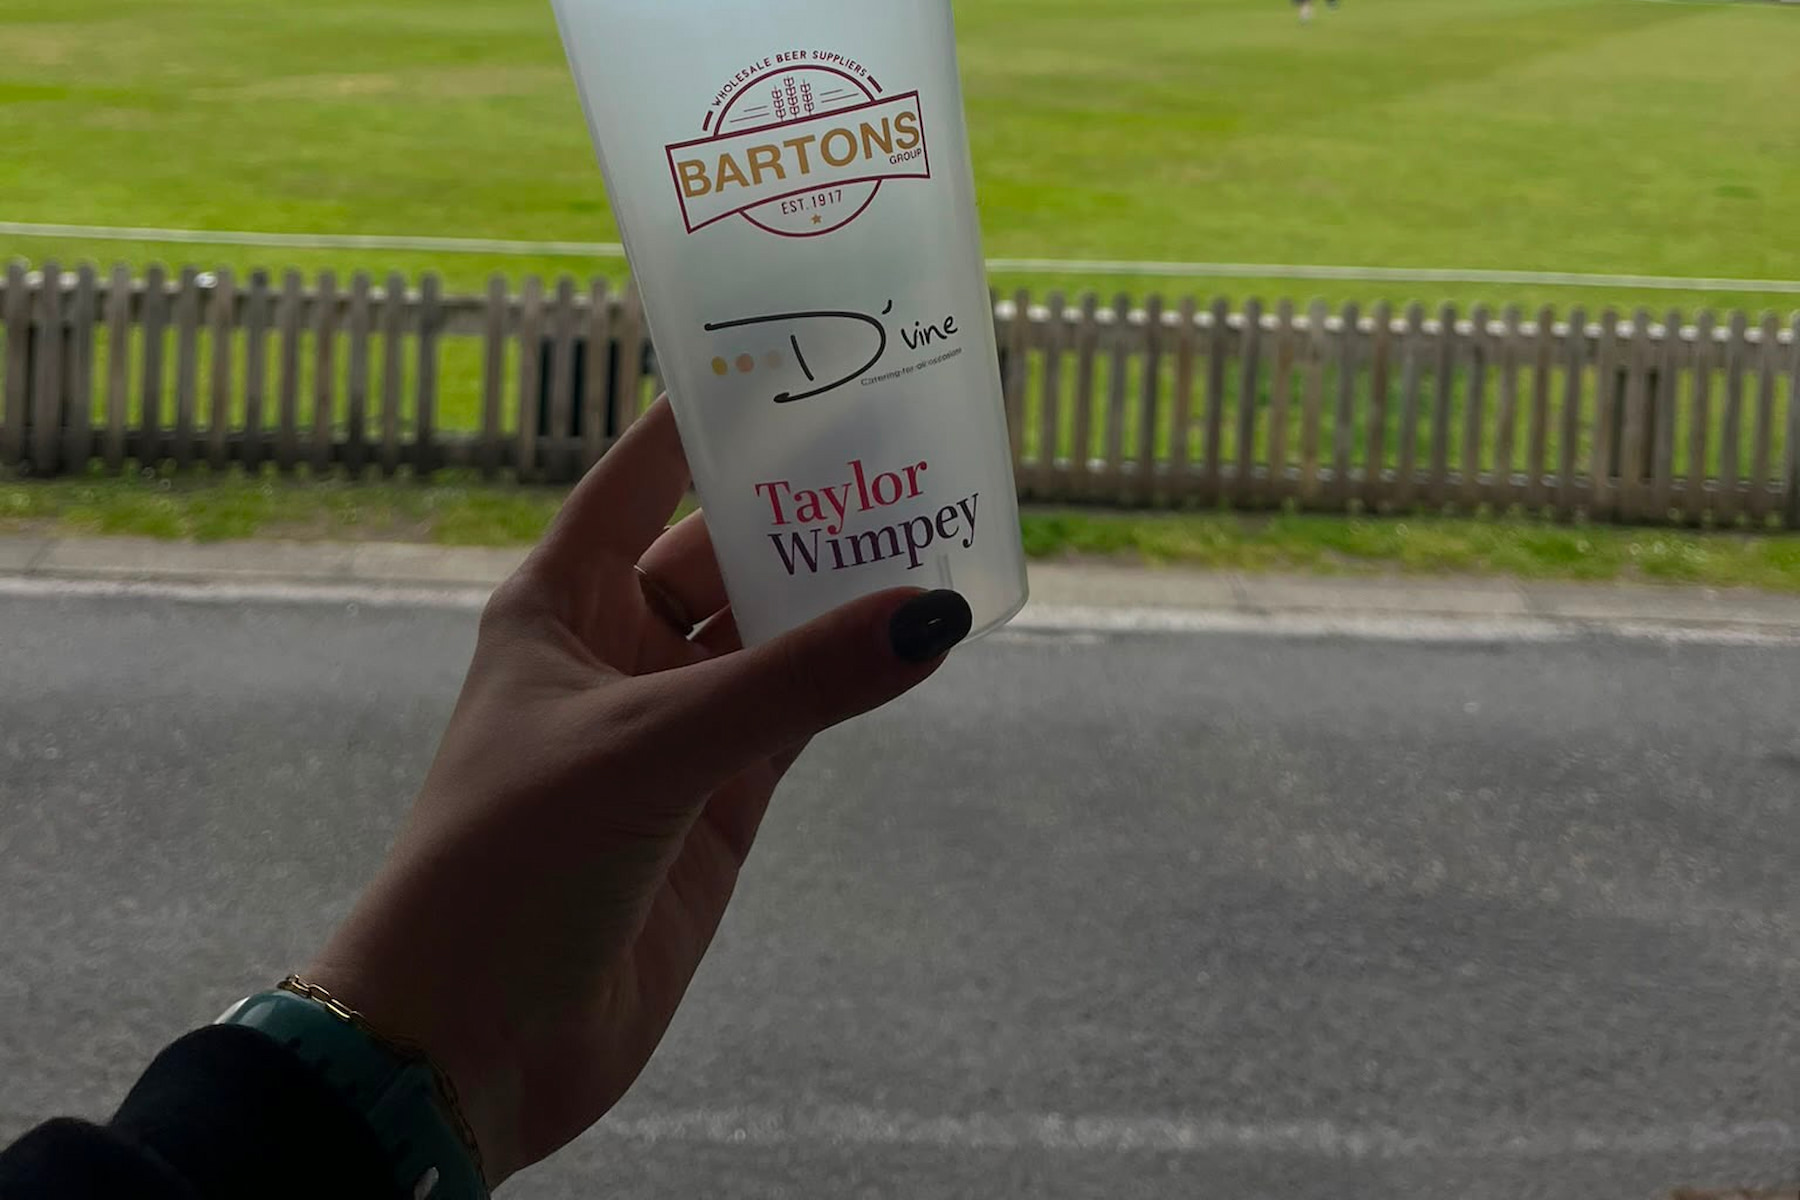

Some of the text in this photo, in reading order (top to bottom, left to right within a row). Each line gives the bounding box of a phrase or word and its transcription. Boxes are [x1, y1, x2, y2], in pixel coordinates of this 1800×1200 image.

[711, 50, 868, 107] WHOLESALE BEER SUPPLIERS
[677, 111, 920, 198] BARTONS
[889, 148, 922, 165] GROUP
[781, 189, 843, 215] EST. 1917
[755, 459, 928, 536] Taylor
[767, 493, 979, 576] Wimpey
